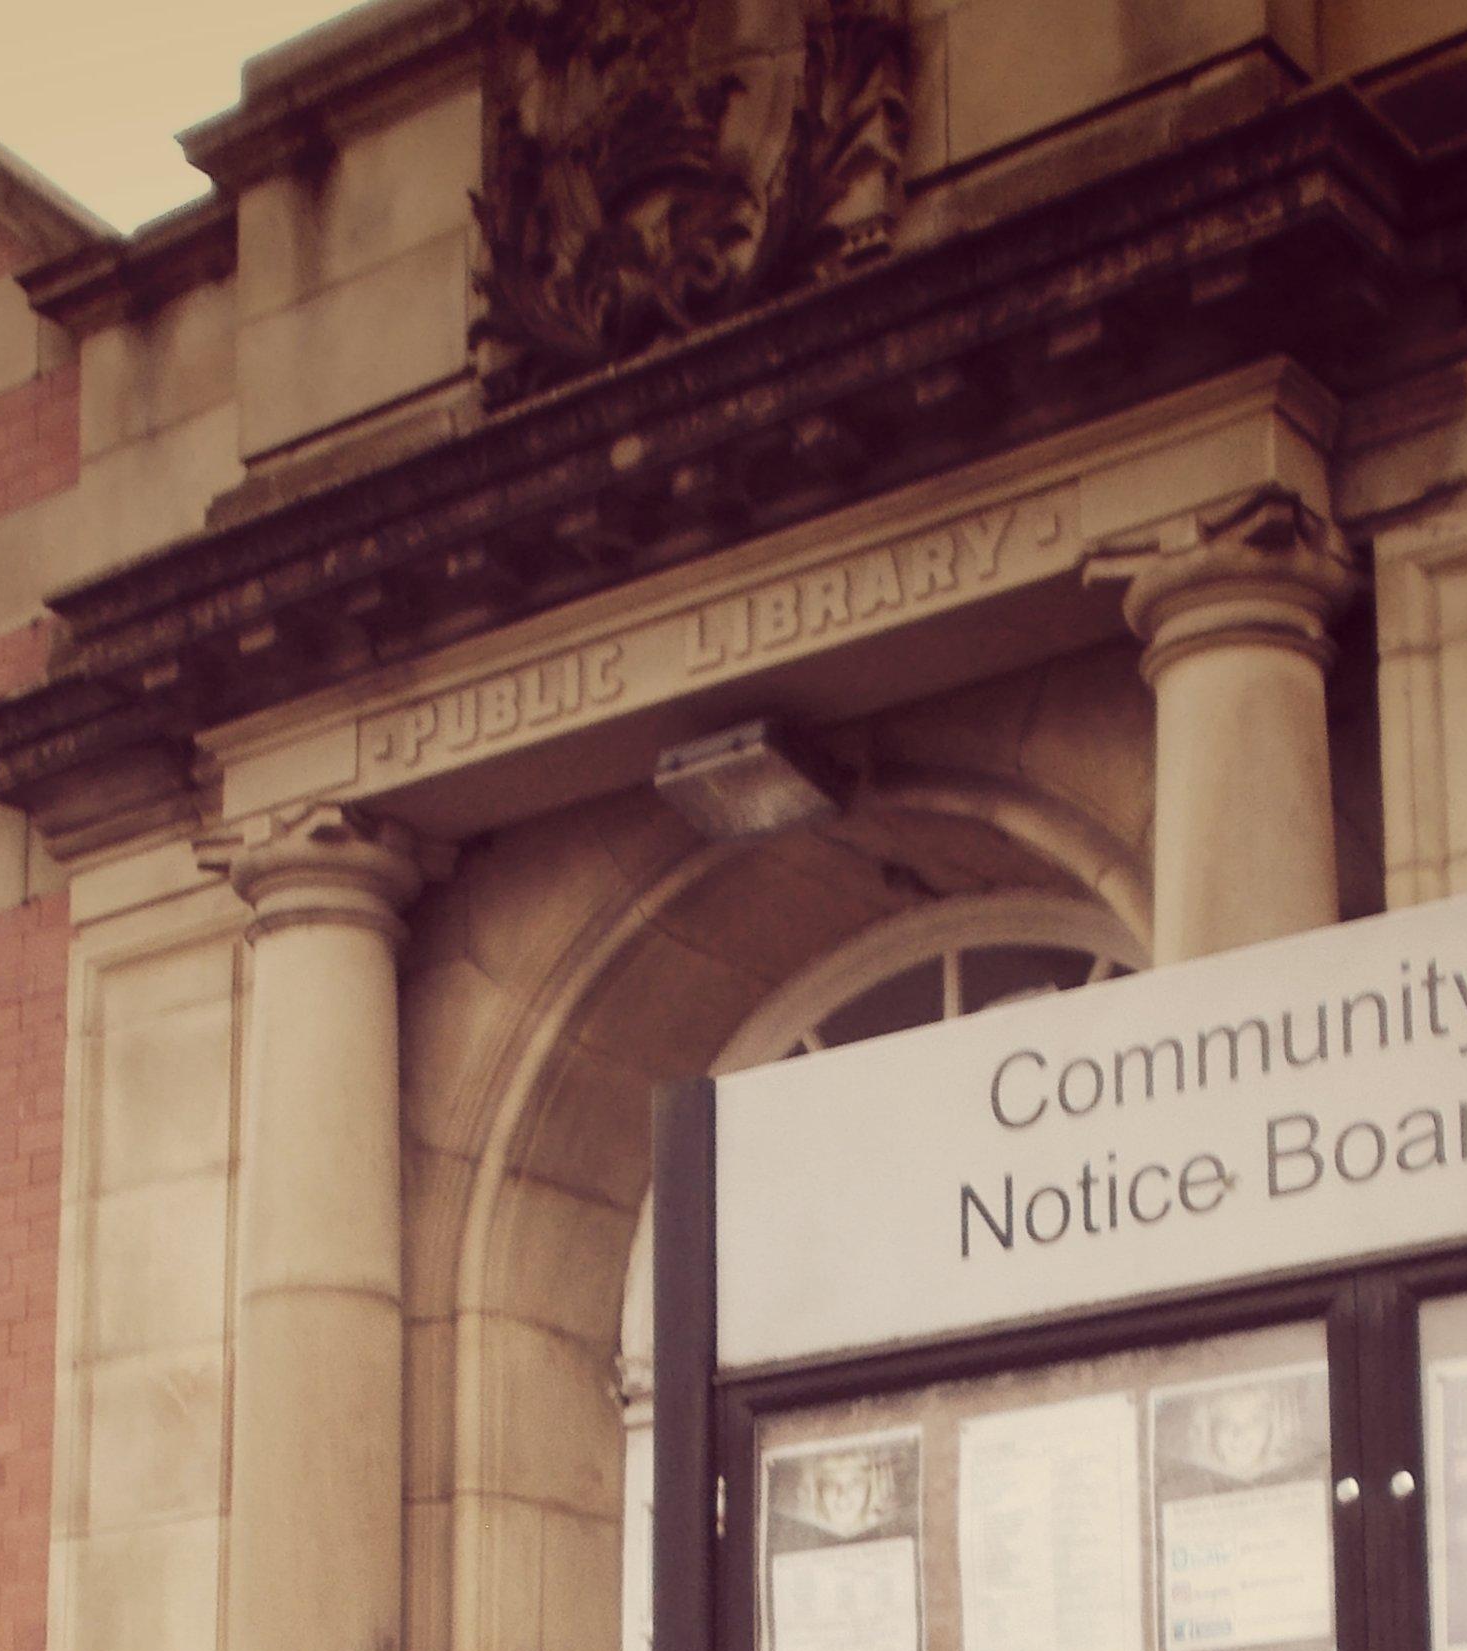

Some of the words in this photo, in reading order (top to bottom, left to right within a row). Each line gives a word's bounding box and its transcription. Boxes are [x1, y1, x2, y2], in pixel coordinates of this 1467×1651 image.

[398, 641, 625, 769] PUBLIC
[684, 508, 1018, 673] LIBRARY
[959, 1151, 1235, 1260] Notice
